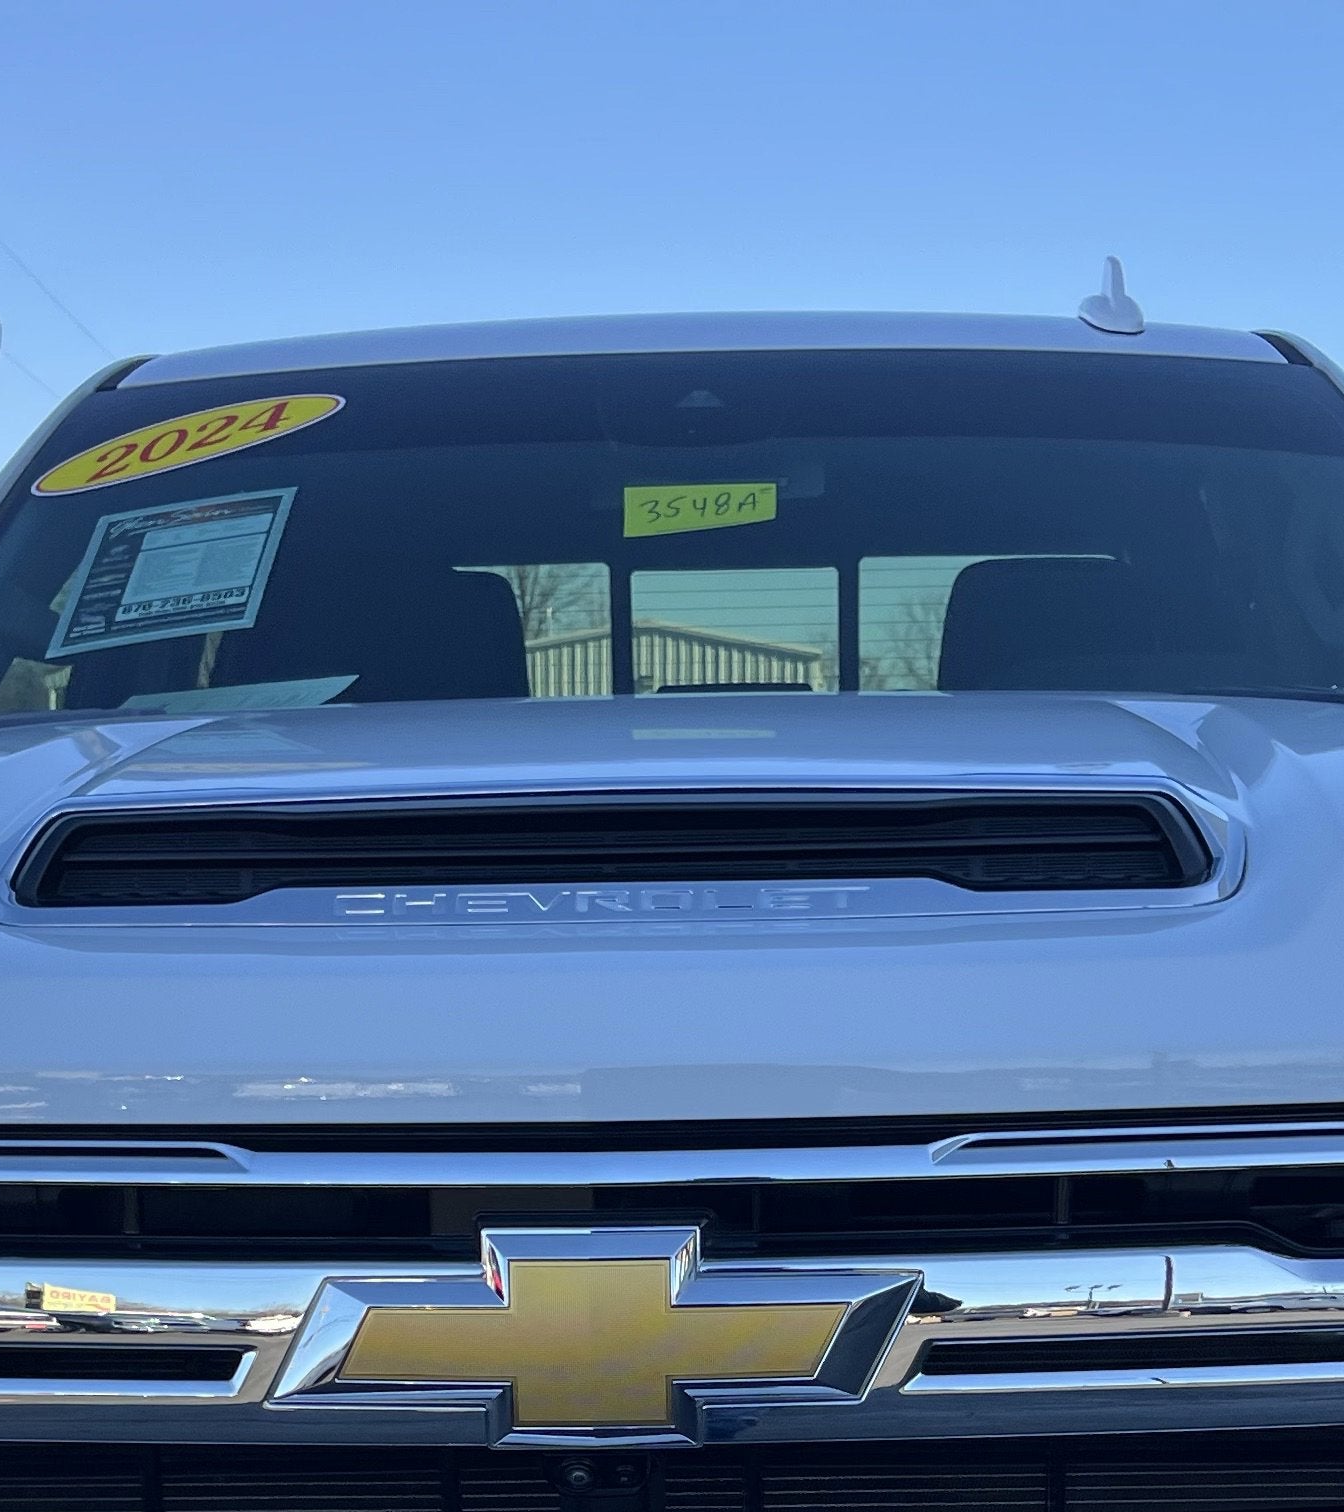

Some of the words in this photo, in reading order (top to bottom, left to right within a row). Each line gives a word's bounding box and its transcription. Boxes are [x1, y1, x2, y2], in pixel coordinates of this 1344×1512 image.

[85, 401, 291, 483] 2024
[639, 491, 758, 524] 3548A
[336, 887, 870, 915] CHEVROLET
